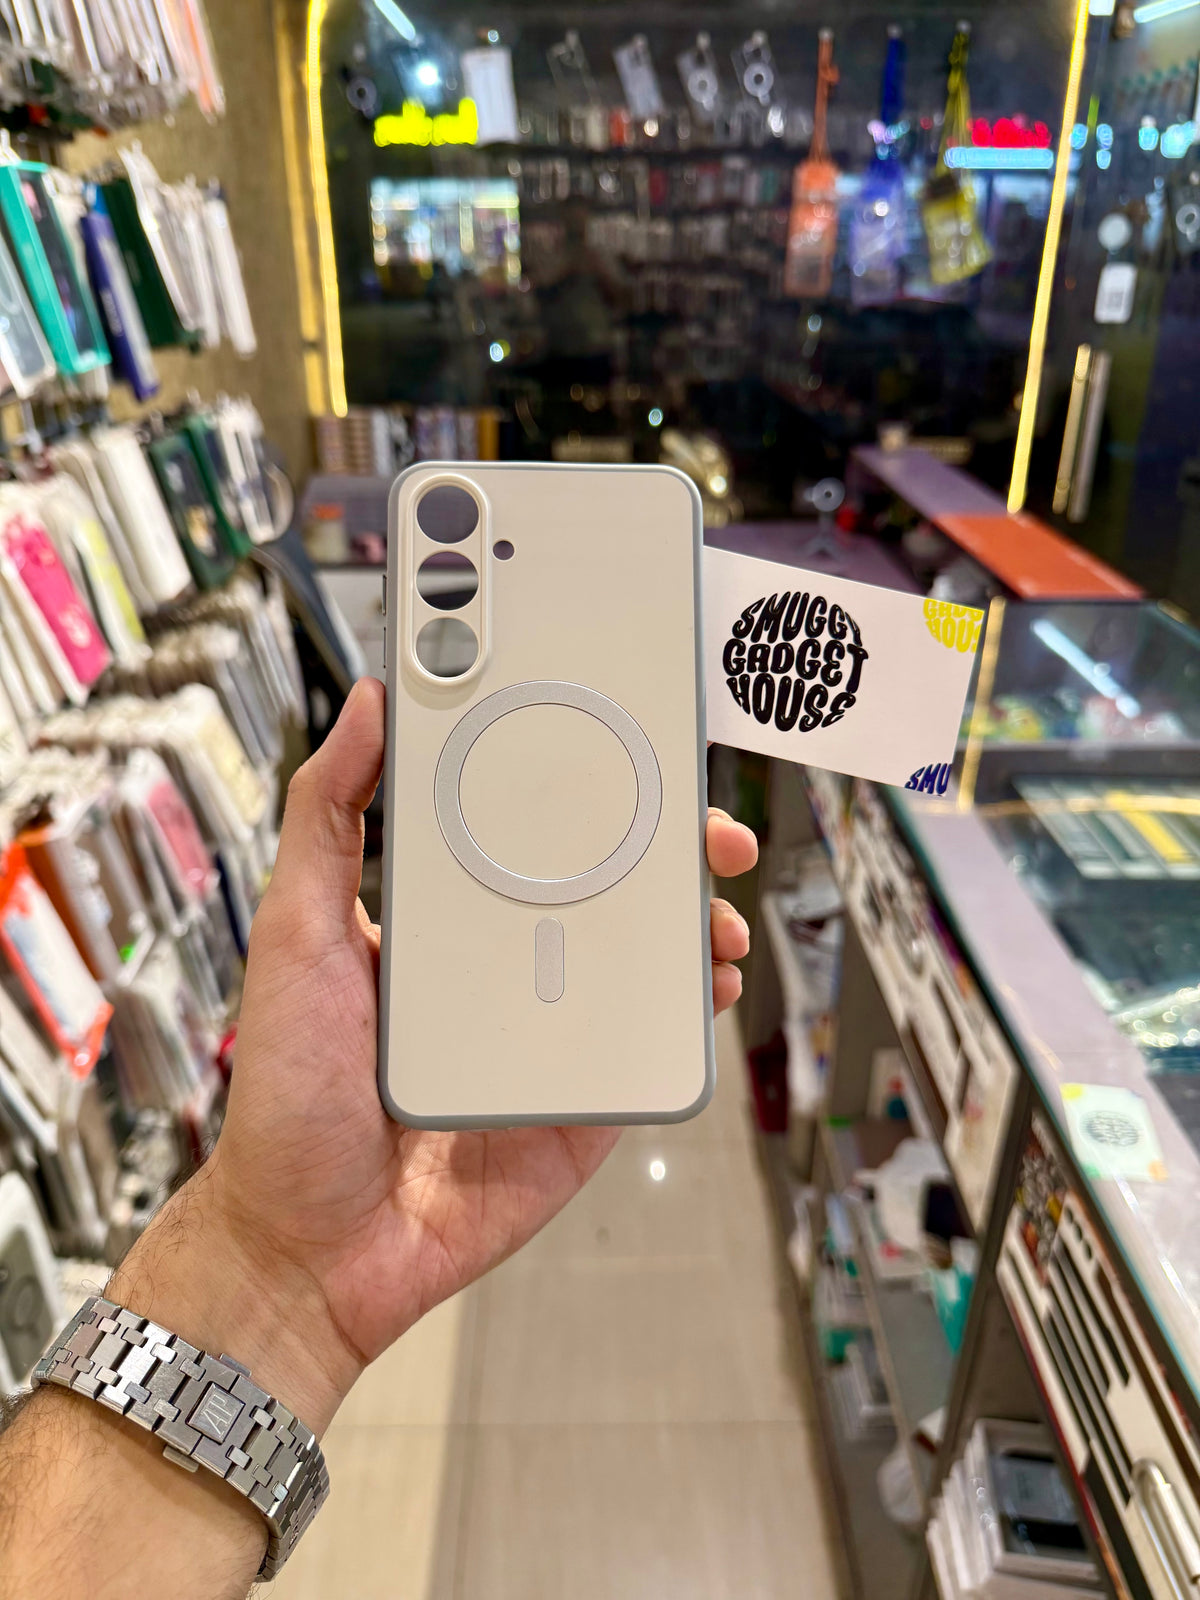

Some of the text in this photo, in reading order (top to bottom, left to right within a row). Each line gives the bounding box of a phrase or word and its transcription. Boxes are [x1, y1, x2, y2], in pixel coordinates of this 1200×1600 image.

[731, 591, 863, 647] SMUGGY
[722, 638, 869, 694] GADGET
[726, 672, 857, 733] HOUSE
[904, 762, 952, 795] SMU
